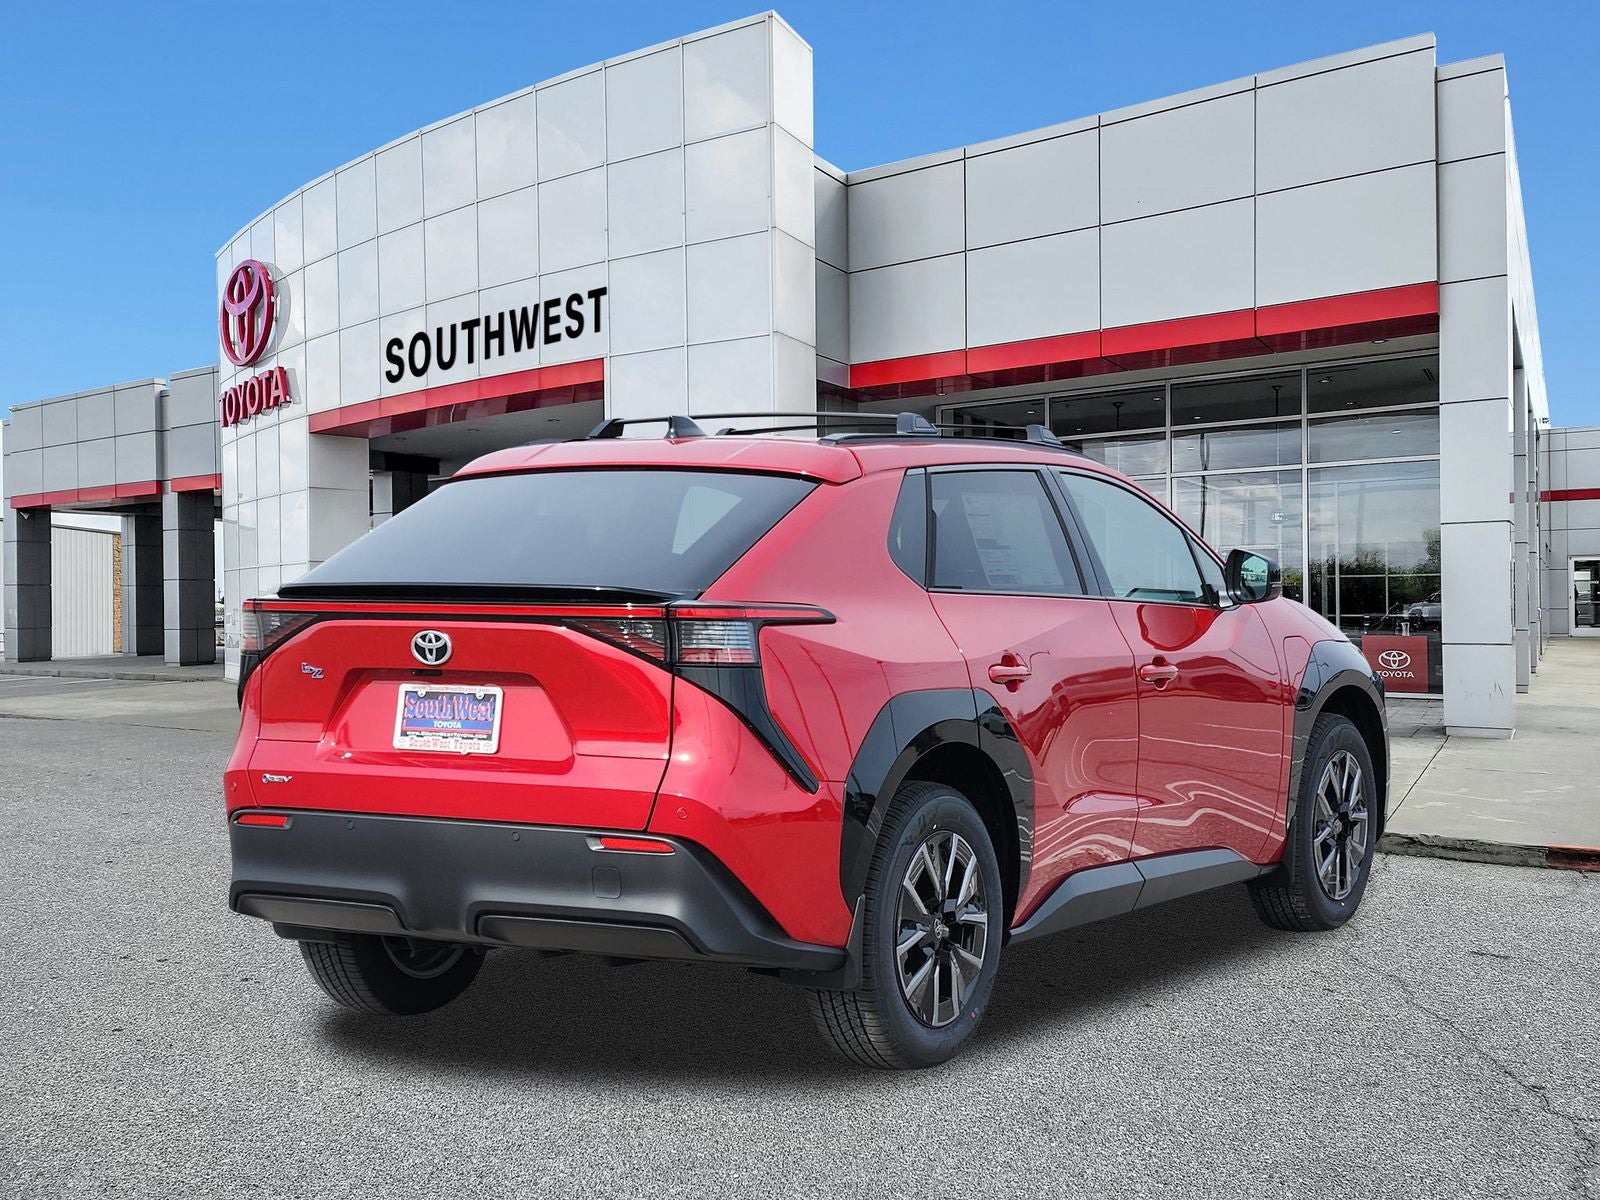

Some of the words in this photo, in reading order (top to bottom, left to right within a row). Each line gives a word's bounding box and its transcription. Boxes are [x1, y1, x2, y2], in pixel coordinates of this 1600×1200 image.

[385, 286, 607, 384] SOUTHWEST
[218, 366, 290, 427] TOYOTA
[433, 720, 462, 729] TOYOTA
